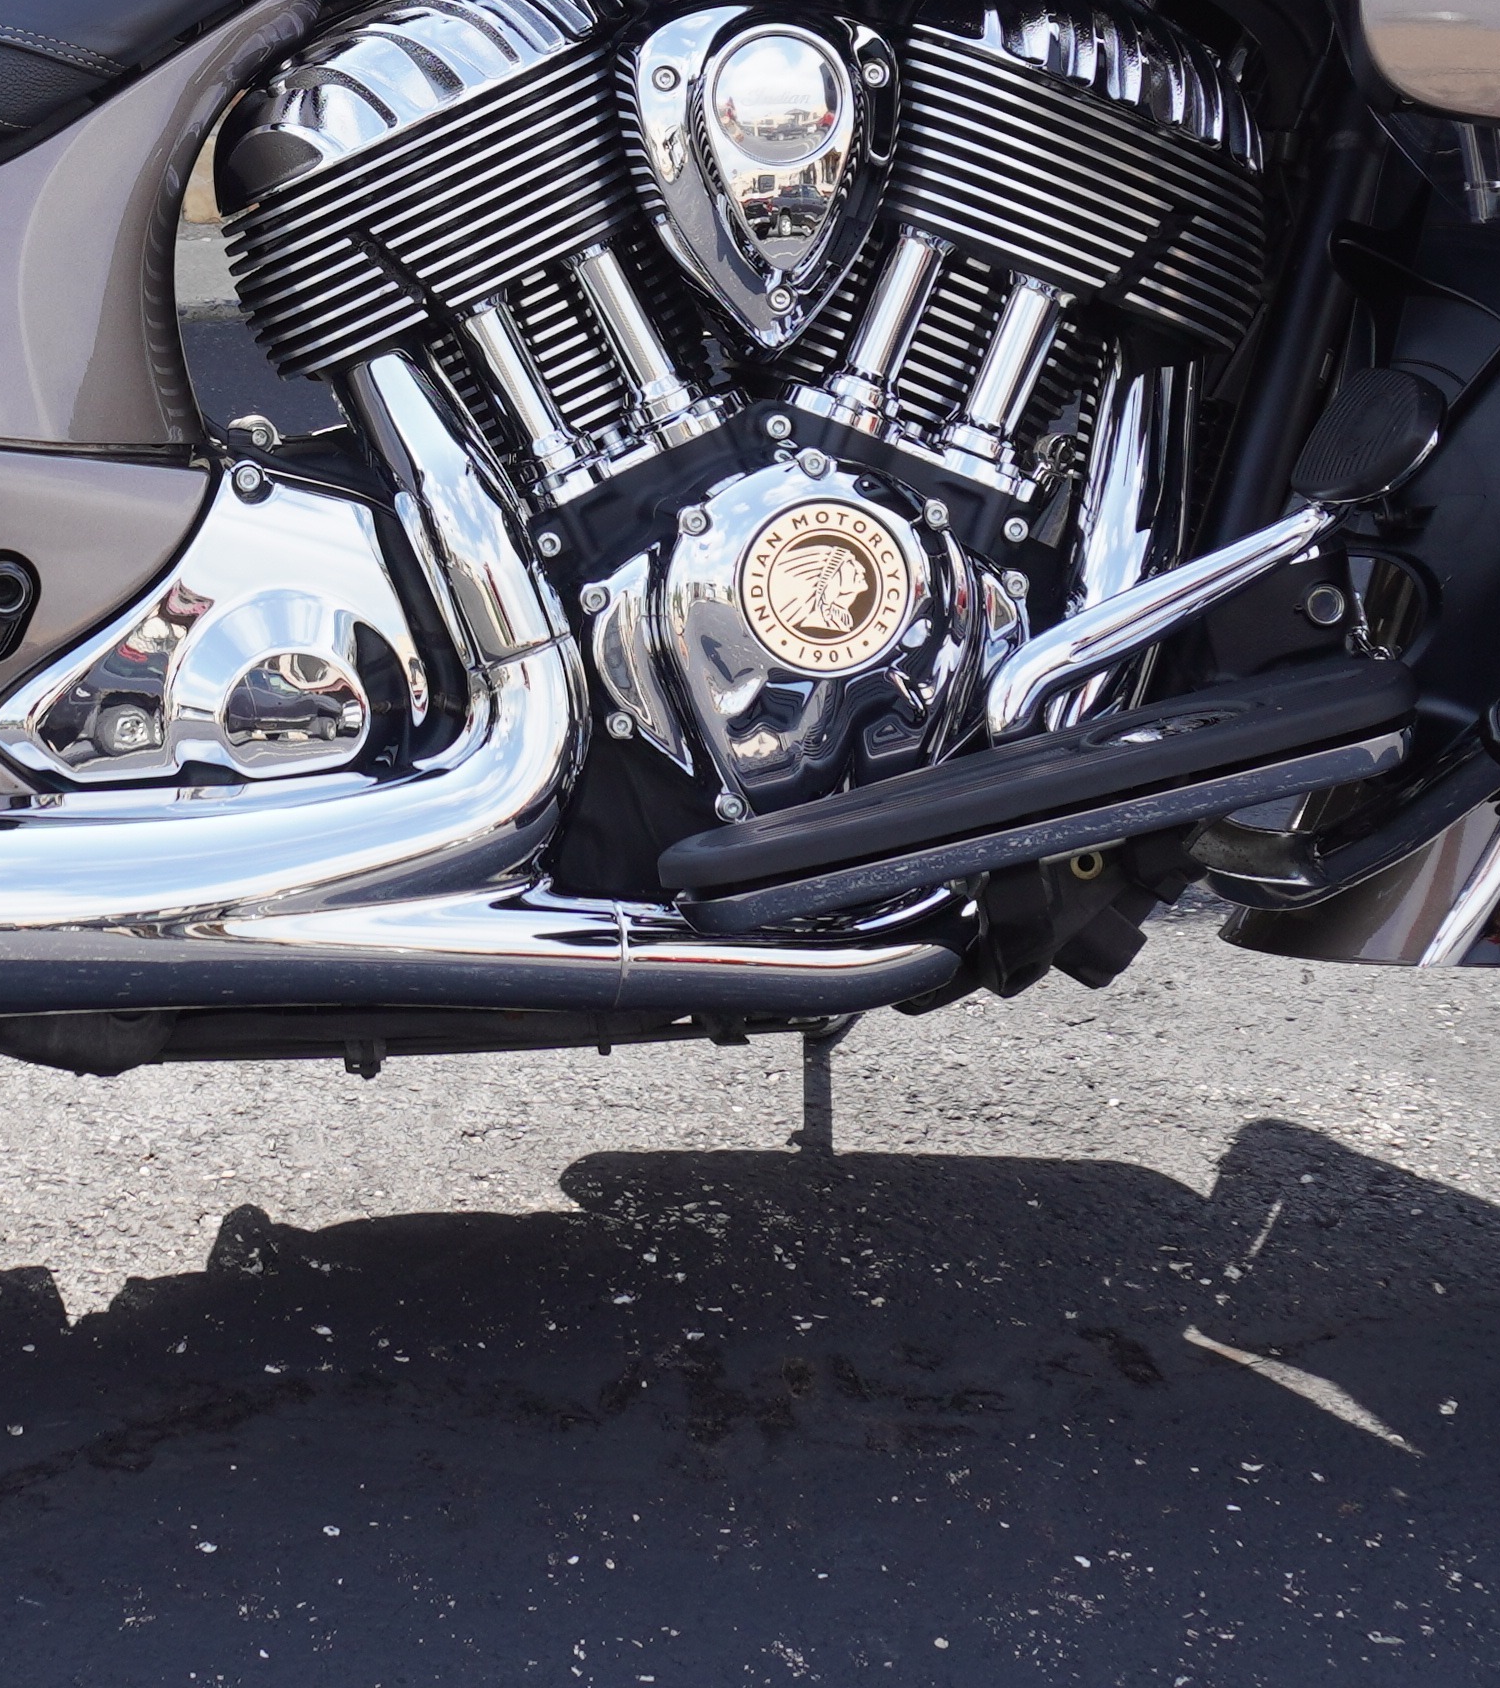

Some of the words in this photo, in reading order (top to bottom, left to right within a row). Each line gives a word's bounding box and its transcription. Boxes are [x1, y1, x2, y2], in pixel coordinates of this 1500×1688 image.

[749, 531, 784, 635] INDIAN
[790, 511, 901, 635] MOTORCYCLE
[798, 645, 855, 664] 1901
